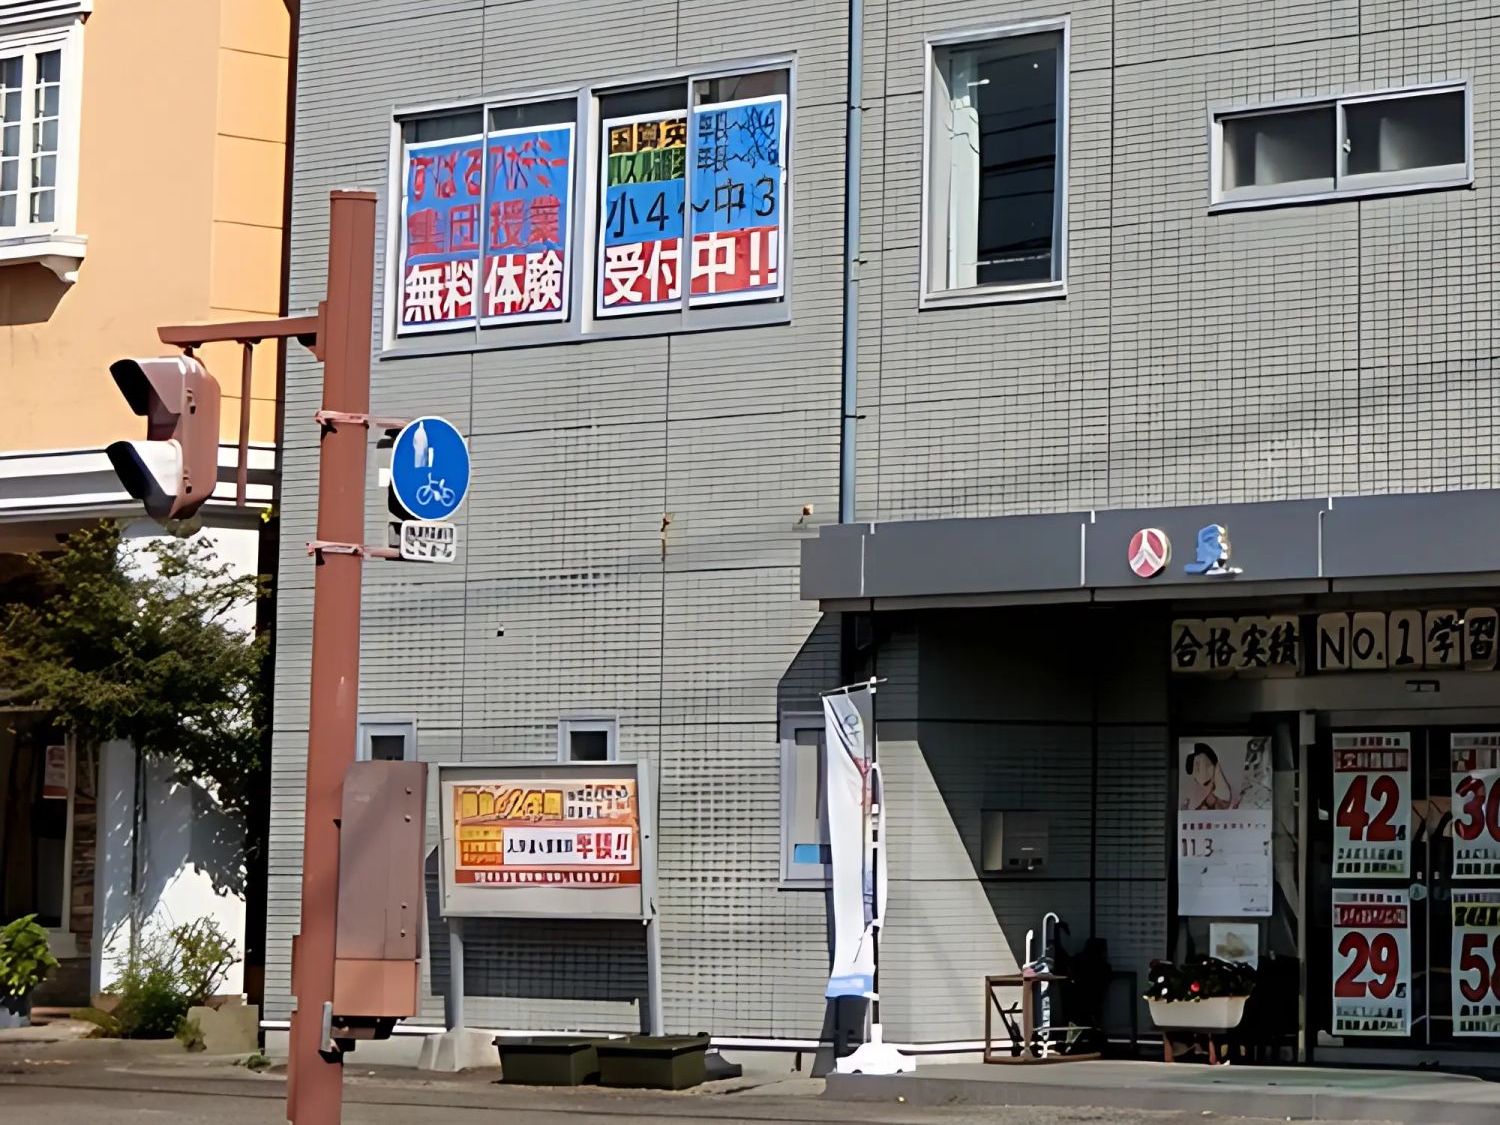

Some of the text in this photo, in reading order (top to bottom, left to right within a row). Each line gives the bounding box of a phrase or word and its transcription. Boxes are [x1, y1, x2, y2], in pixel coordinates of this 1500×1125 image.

[403, 250, 563, 322] 無料体験
[1172, 620, 1300, 670] 合格実績
